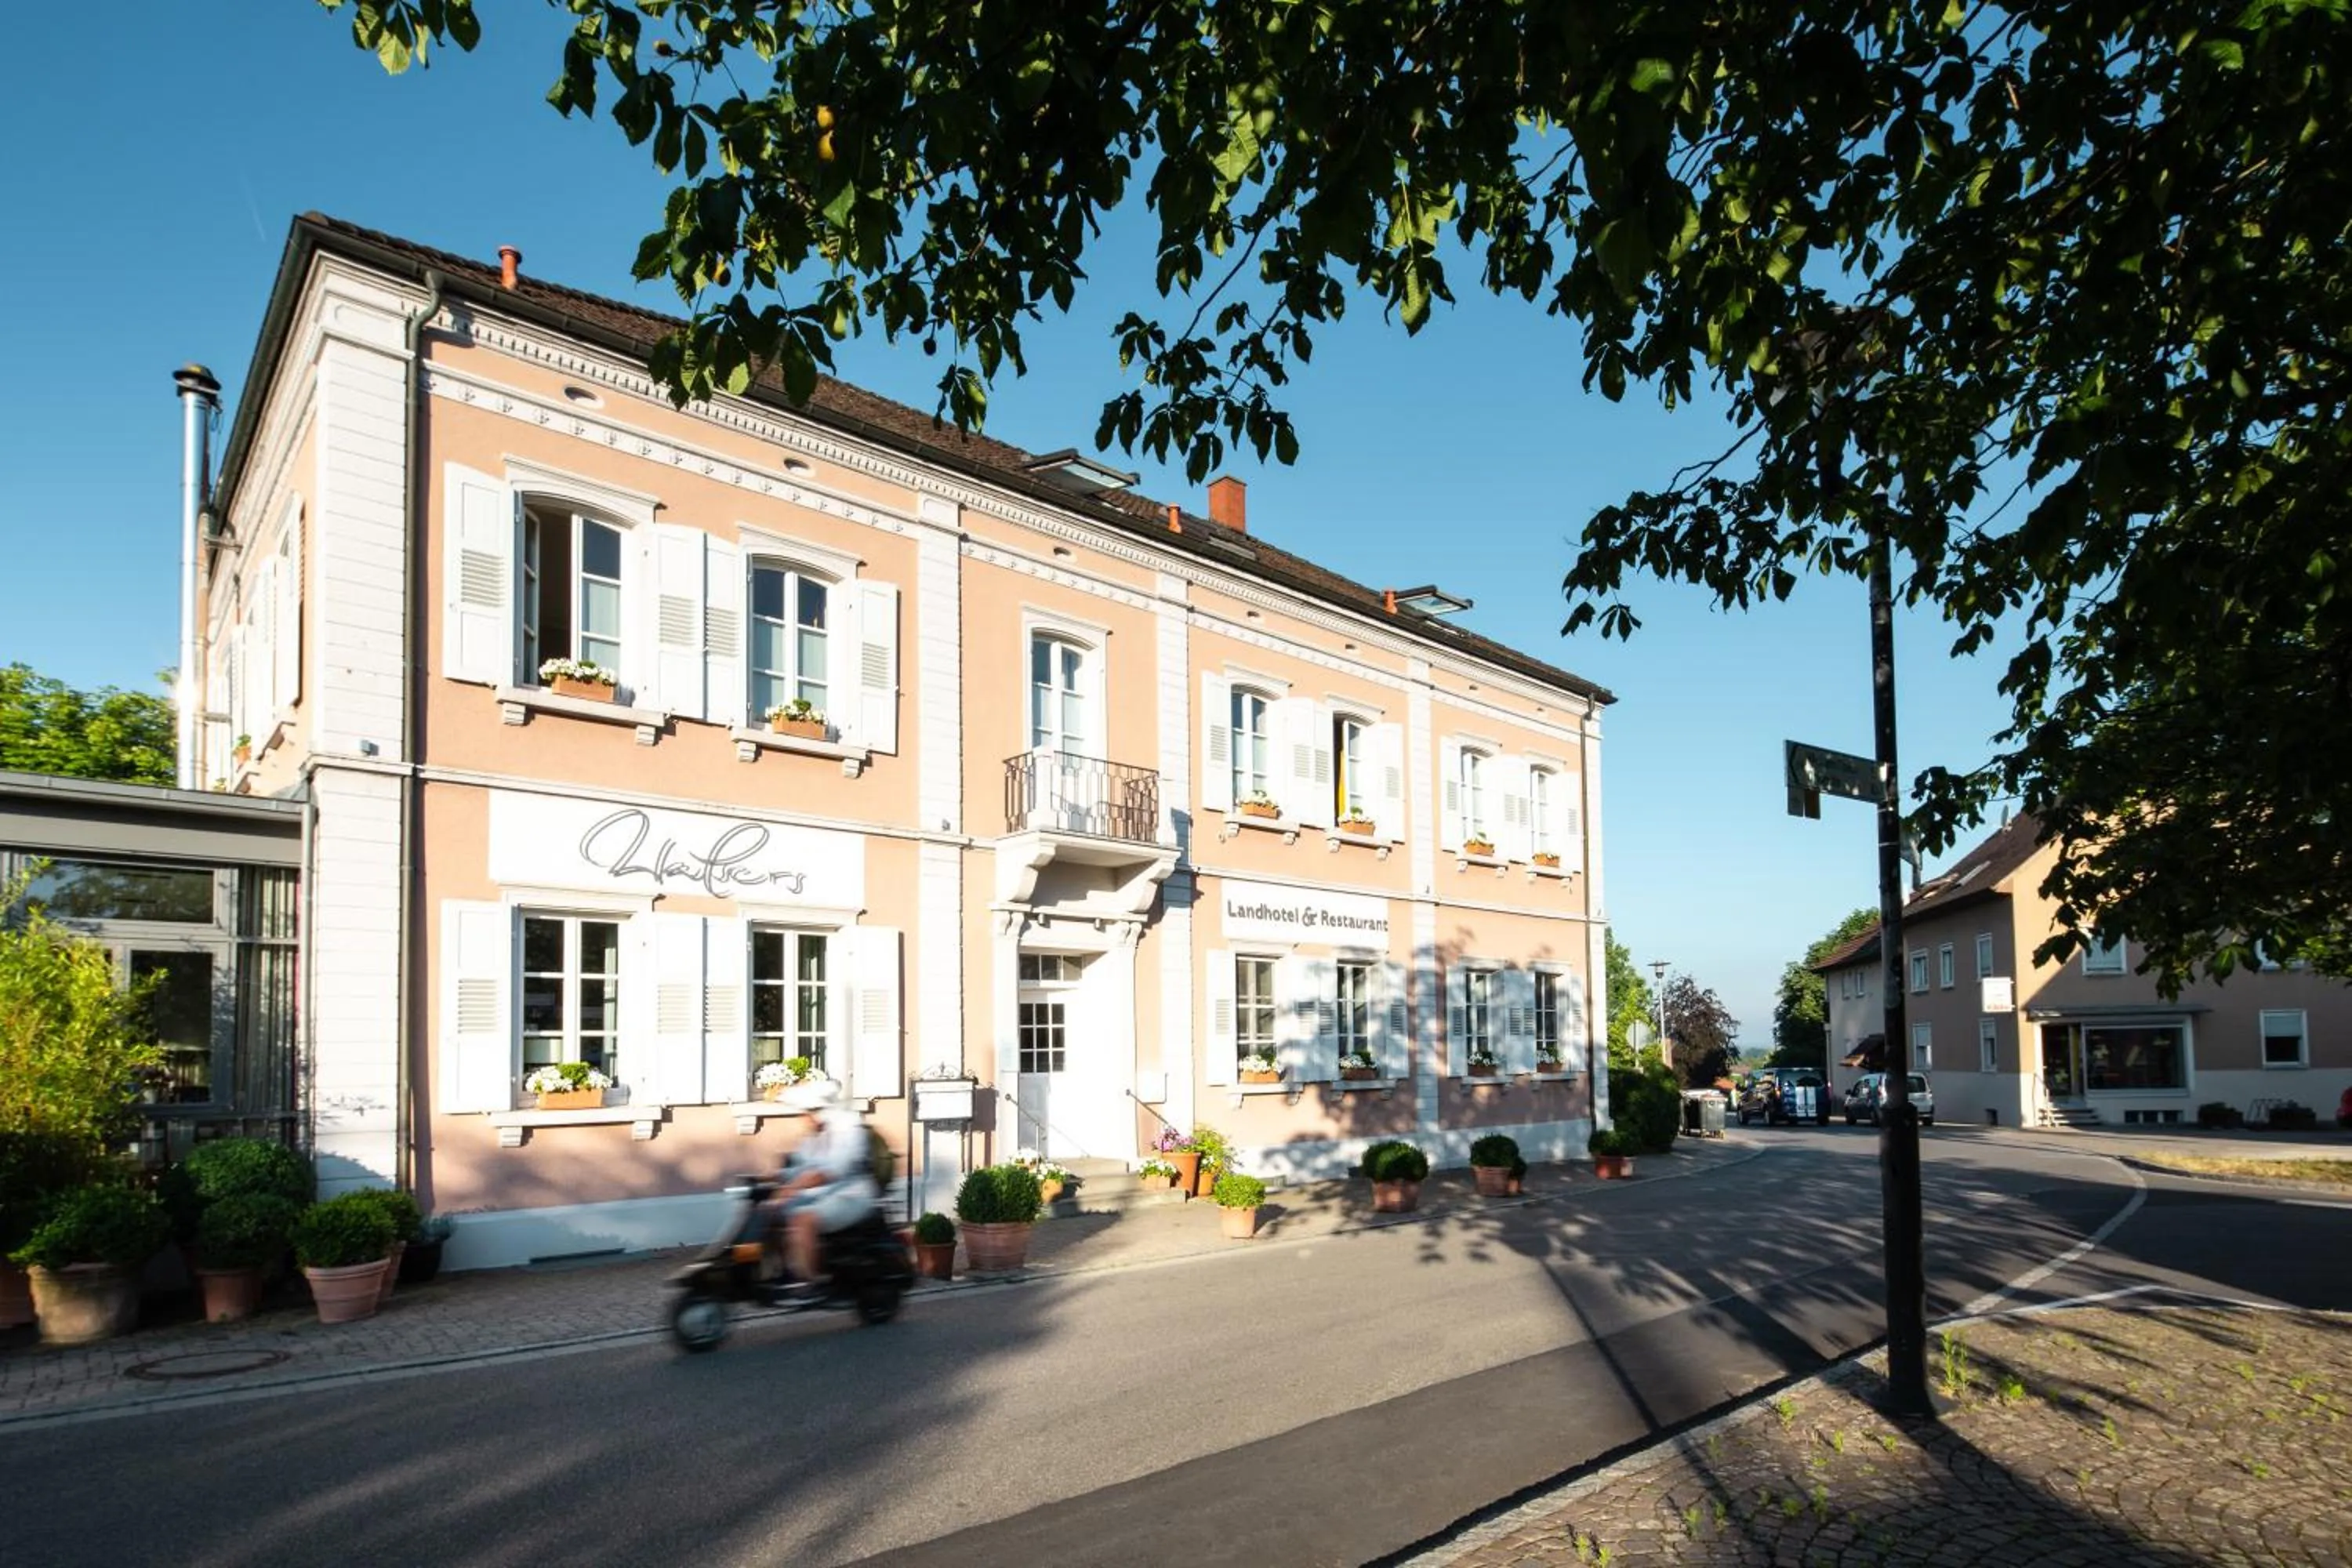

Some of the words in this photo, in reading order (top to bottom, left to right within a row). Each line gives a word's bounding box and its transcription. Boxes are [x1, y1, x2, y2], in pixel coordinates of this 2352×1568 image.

[1227, 899, 1299, 924] Landhotel
[1301, 906, 1318, 927] &
[1320, 909, 1388, 932] Restaurant
